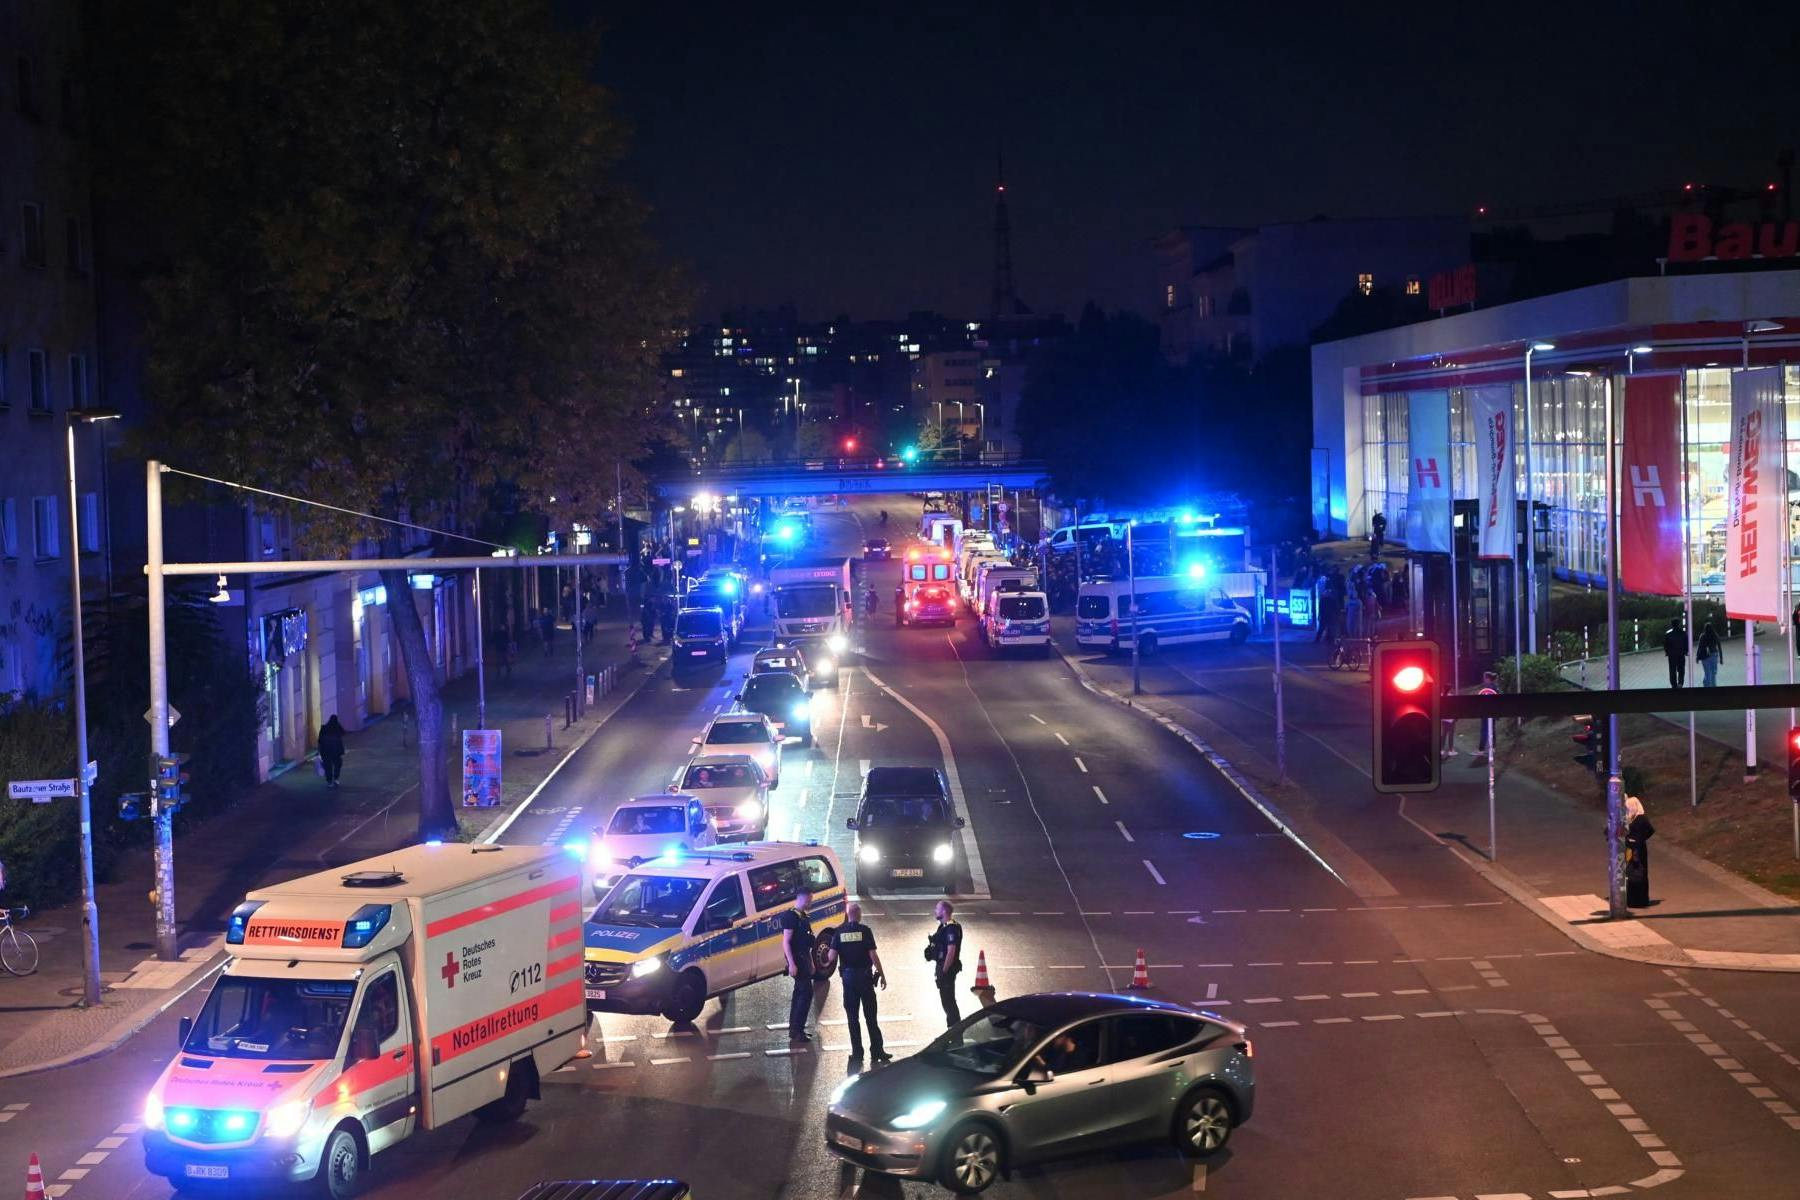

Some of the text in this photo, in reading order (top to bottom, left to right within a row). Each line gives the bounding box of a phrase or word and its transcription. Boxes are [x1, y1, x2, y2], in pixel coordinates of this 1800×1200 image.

[1667, 213, 1799, 262] Bau
[1415, 458, 1441, 489] H
[1630, 465, 1666, 507] H
[12, 783, 71, 794] Bautzer Straße
[248, 925, 340, 941] RETTUNGSDIENST
[590, 929, 641, 940] POLIZEI
[462, 939, 496, 957] Deutsches
[462, 957, 482, 971] Rotes
[463, 969, 482, 983] Kreuz
[521, 962, 542, 988] 112
[452, 1003, 539, 1051] Notfallrettung
